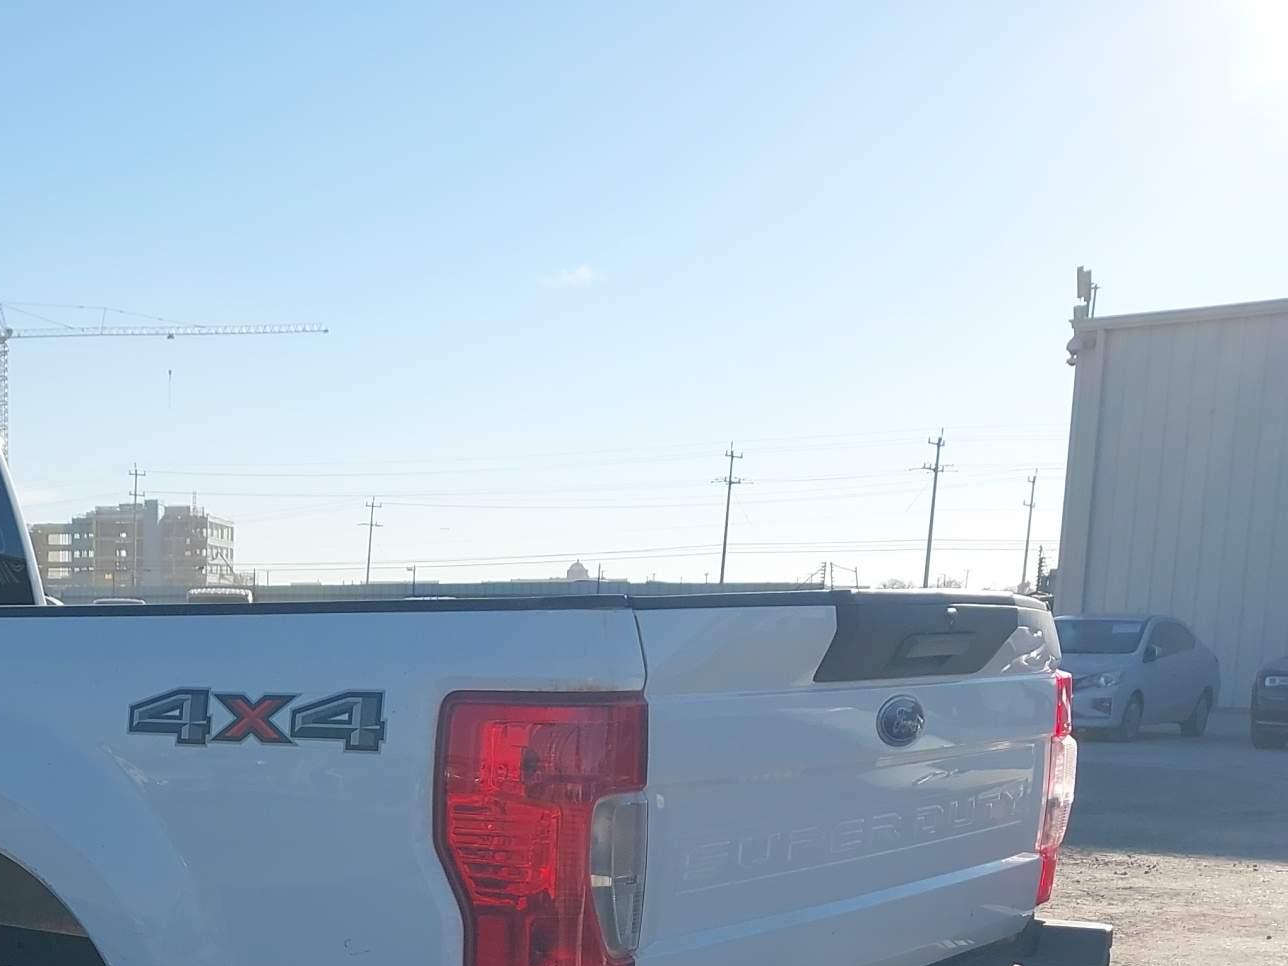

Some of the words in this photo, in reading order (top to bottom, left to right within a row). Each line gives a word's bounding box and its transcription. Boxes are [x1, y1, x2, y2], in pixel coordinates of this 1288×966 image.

[128, 687, 386, 752] 4X4
[683, 812, 902, 882] SUPER
[915, 780, 1030, 835] DUTY
